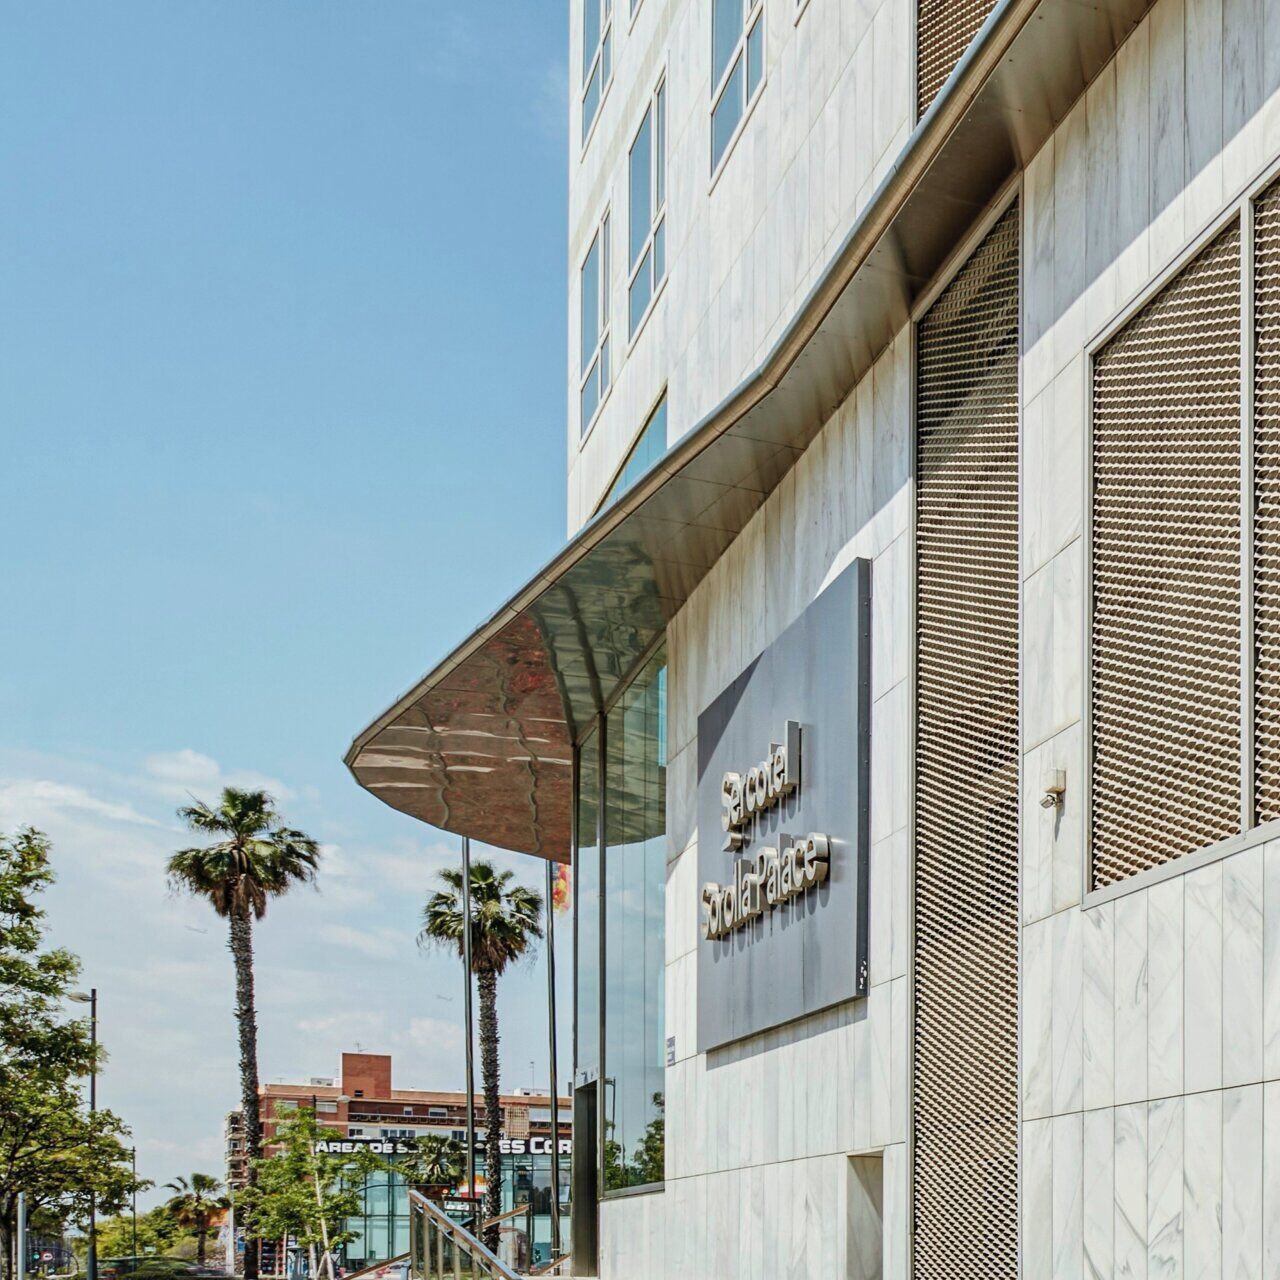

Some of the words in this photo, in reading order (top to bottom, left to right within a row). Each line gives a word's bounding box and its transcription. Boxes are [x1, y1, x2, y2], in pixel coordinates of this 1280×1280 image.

[721, 719, 800, 833] Sercotel
[702, 858, 758, 941] Sorolla
[756, 832, 829, 912] Palace
